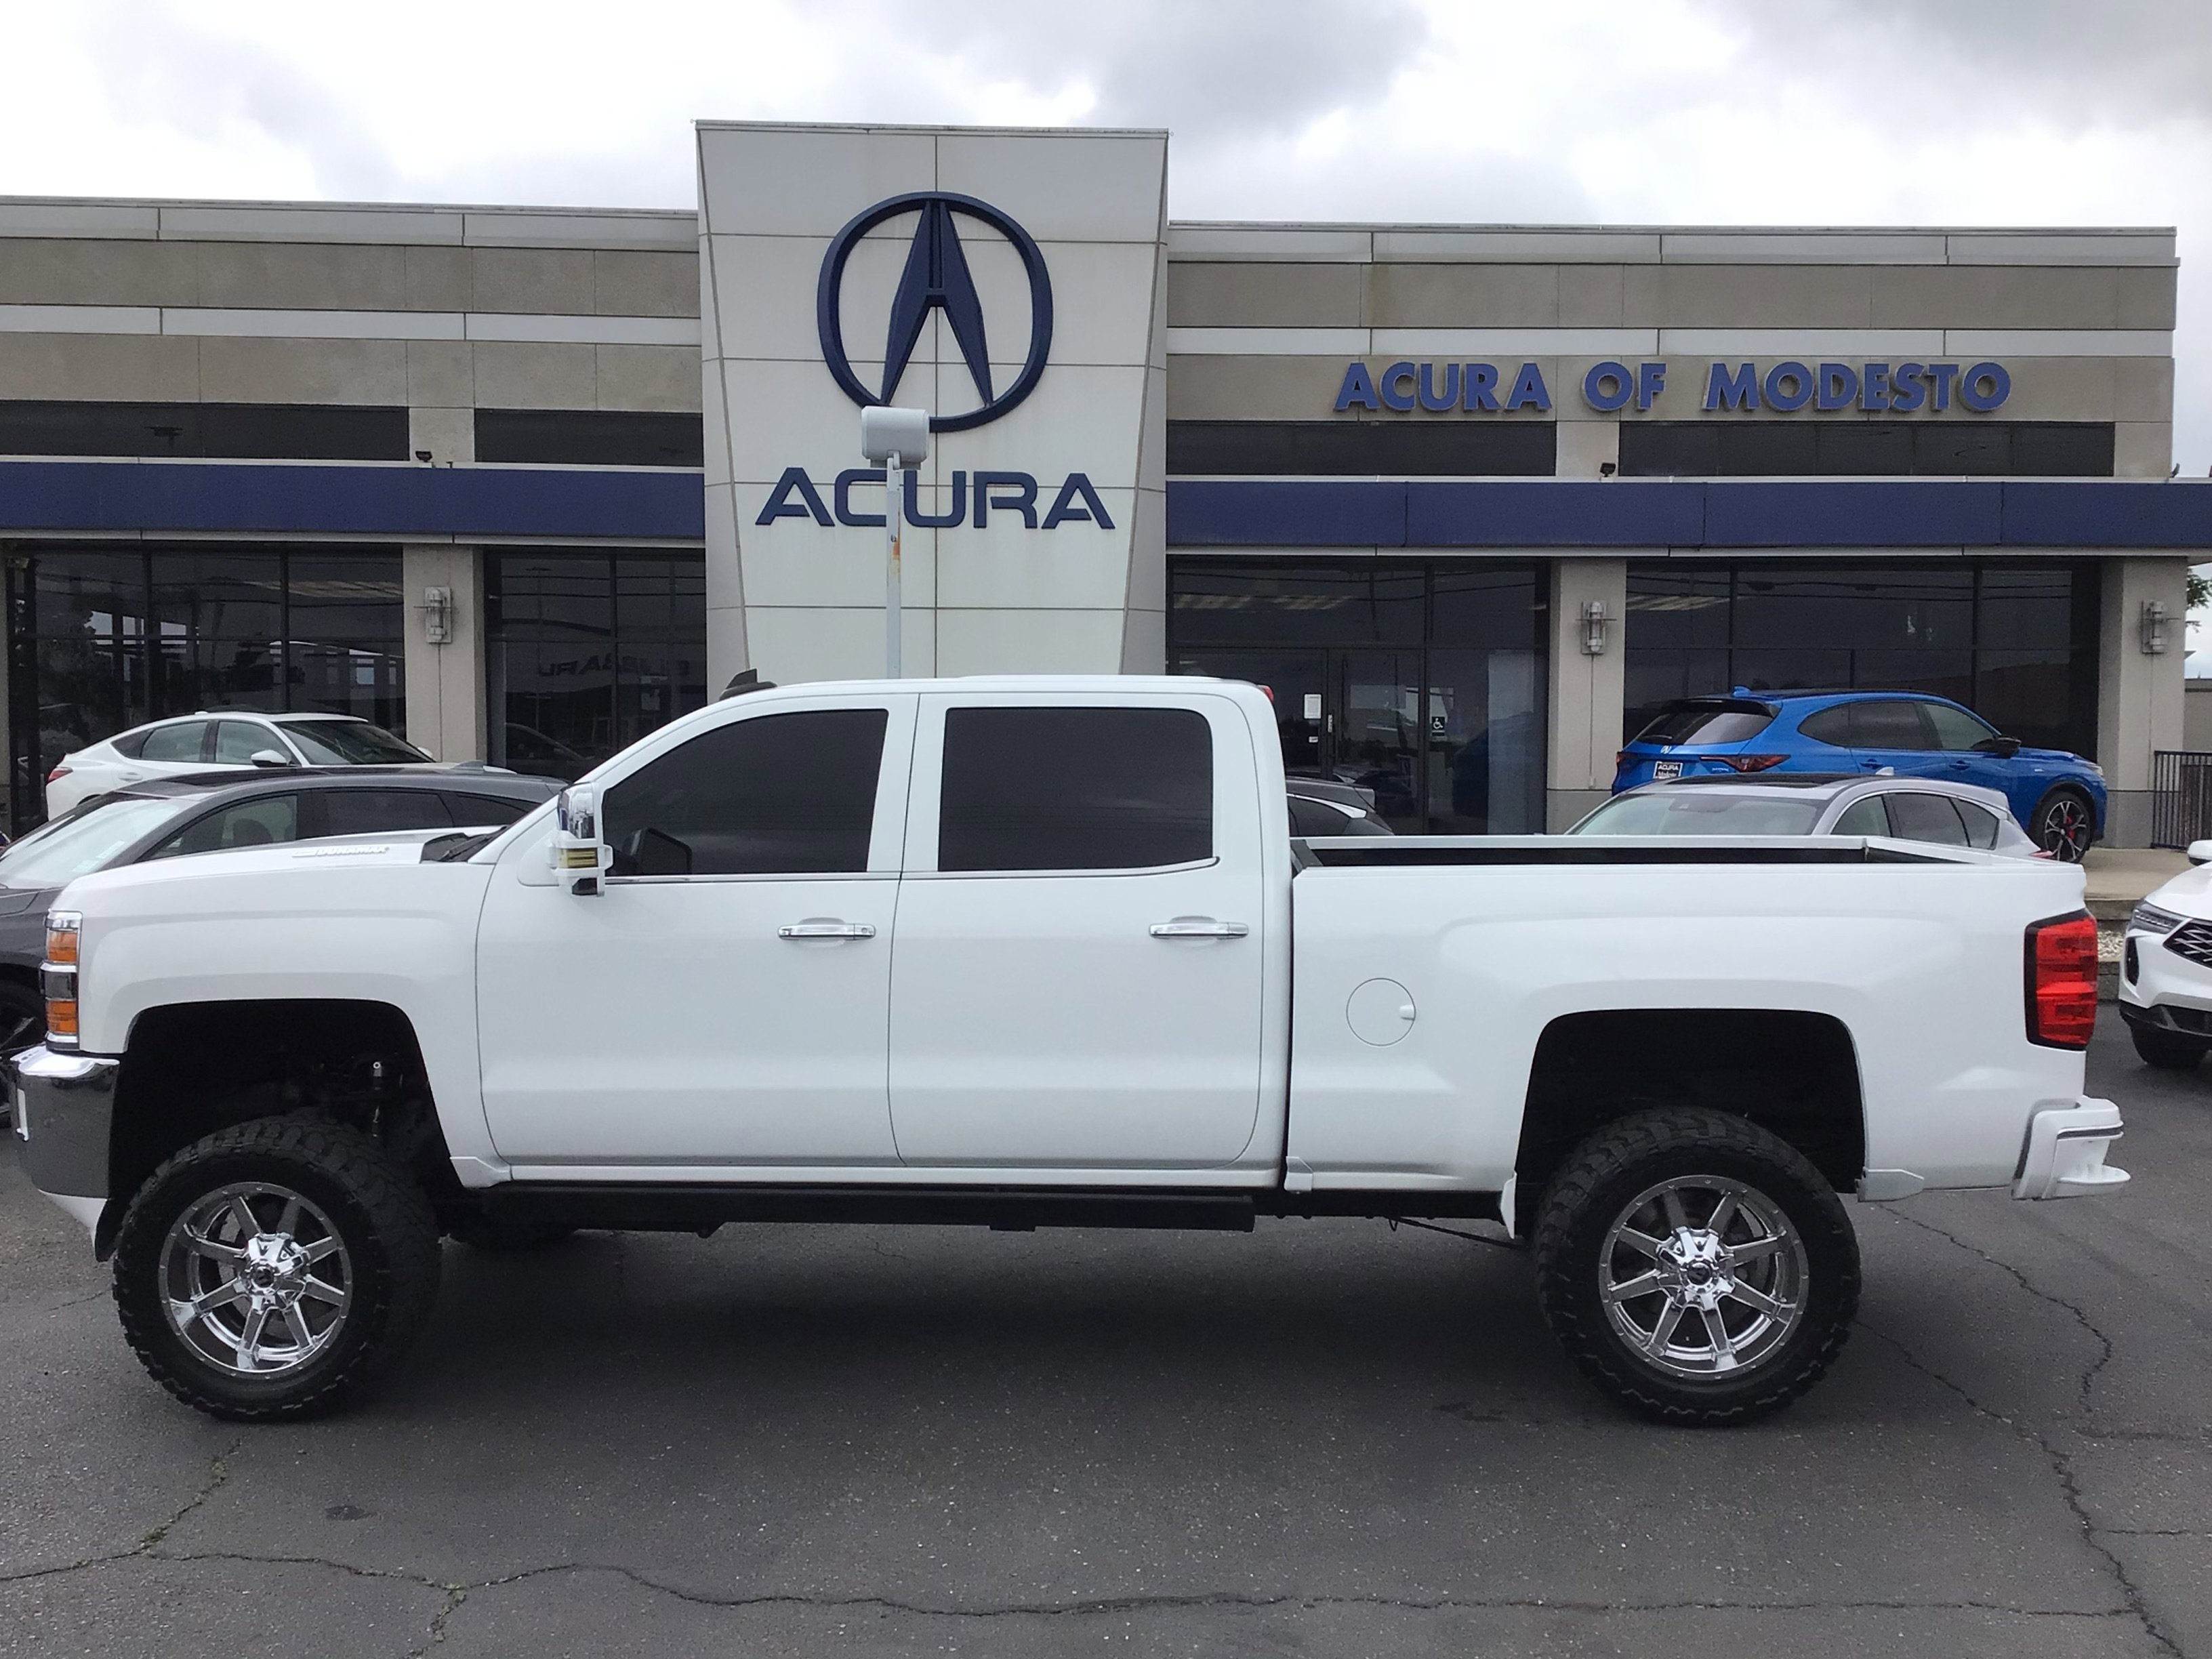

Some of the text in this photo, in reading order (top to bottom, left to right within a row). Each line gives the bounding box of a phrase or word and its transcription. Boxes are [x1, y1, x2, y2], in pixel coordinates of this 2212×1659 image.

[1334, 361, 2012, 412] ACURA OF MODESTO
[754, 466, 1116, 529] ACURA
